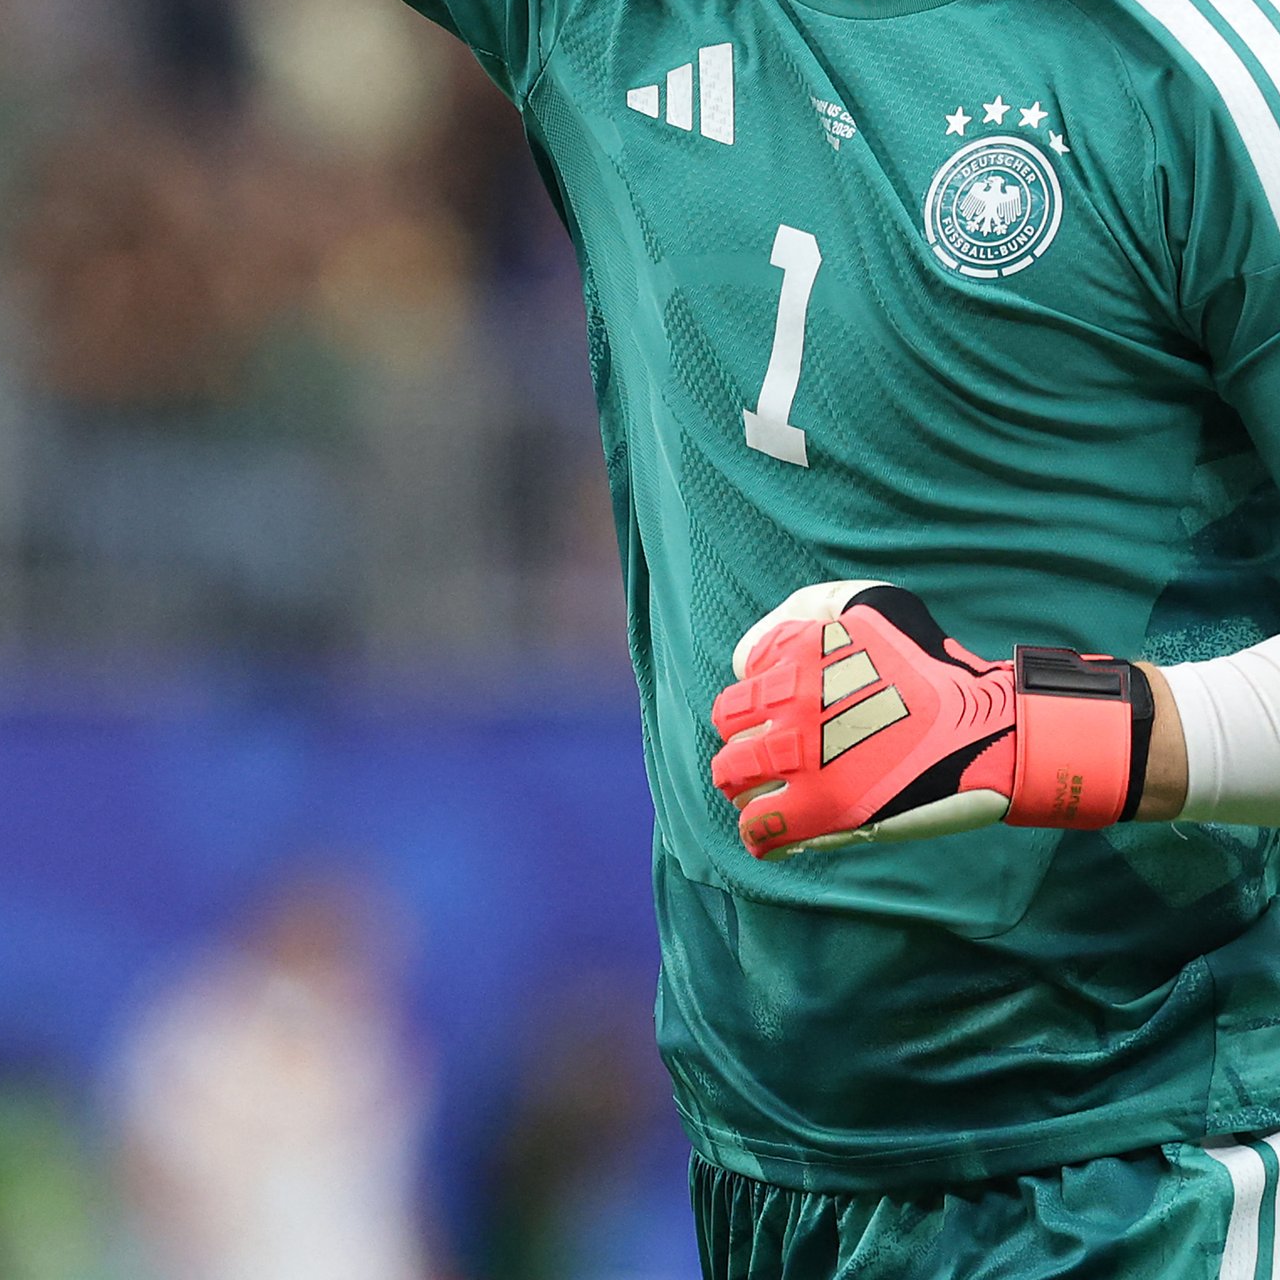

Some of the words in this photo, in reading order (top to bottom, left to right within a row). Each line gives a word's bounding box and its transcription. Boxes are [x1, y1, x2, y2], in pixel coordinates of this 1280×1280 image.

[832, 120, 856, 139] 2026
[963, 154, 1036, 184] DEUTSCHER
[942, 218, 1035, 259] FUSSBALL-BUND
[743, 224, 822, 468] 1
